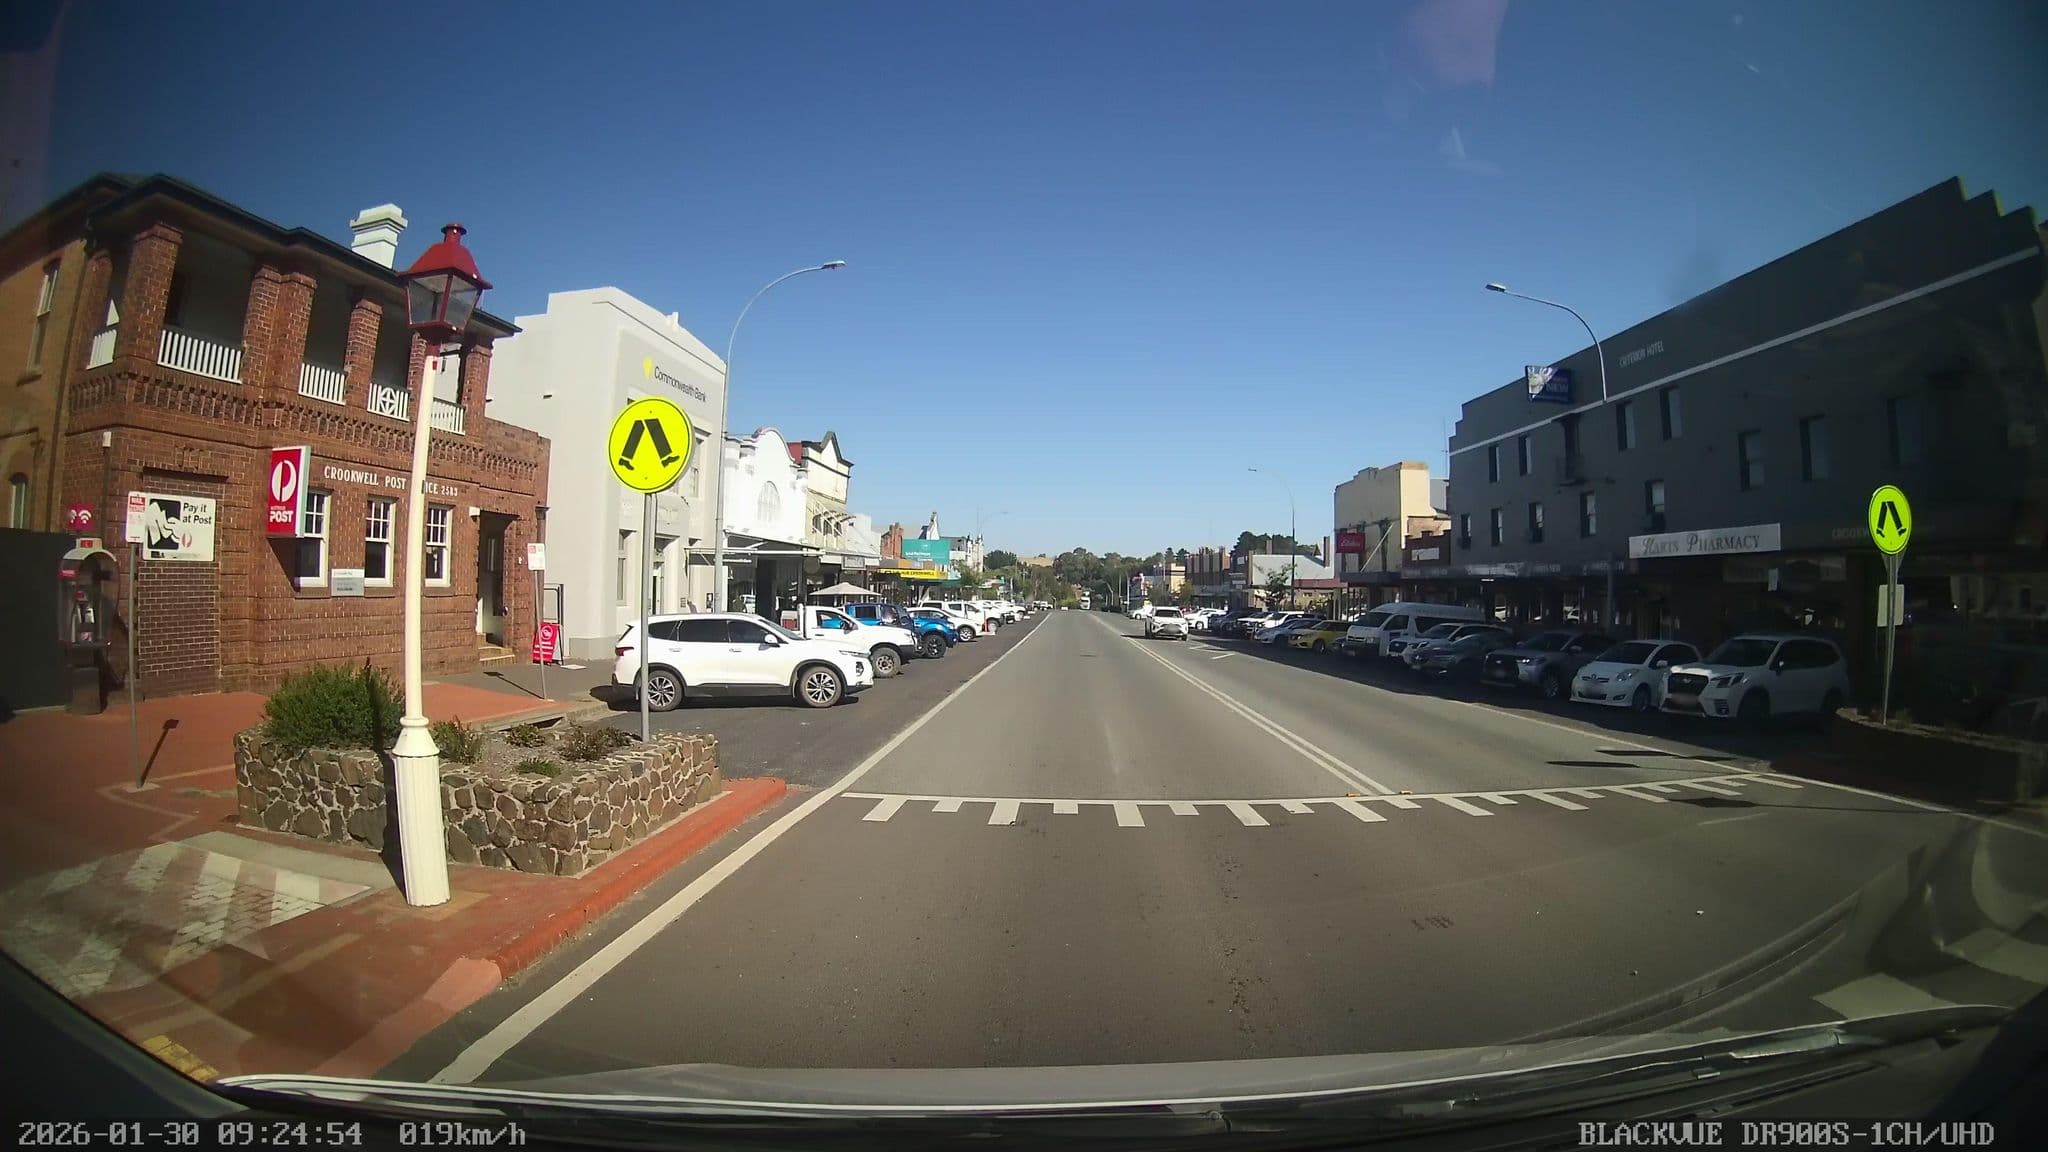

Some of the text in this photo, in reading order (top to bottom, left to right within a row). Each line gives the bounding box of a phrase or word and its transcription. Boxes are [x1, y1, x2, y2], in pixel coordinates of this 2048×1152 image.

[1647, 340, 1665, 357] HOTEL
[323, 465, 379, 487] CROOKWELL
[384, 475, 407, 490] POST
[183, 502, 207, 514] Pay it
[182, 514, 212, 525] at Post
[269, 510, 294, 523] POST
